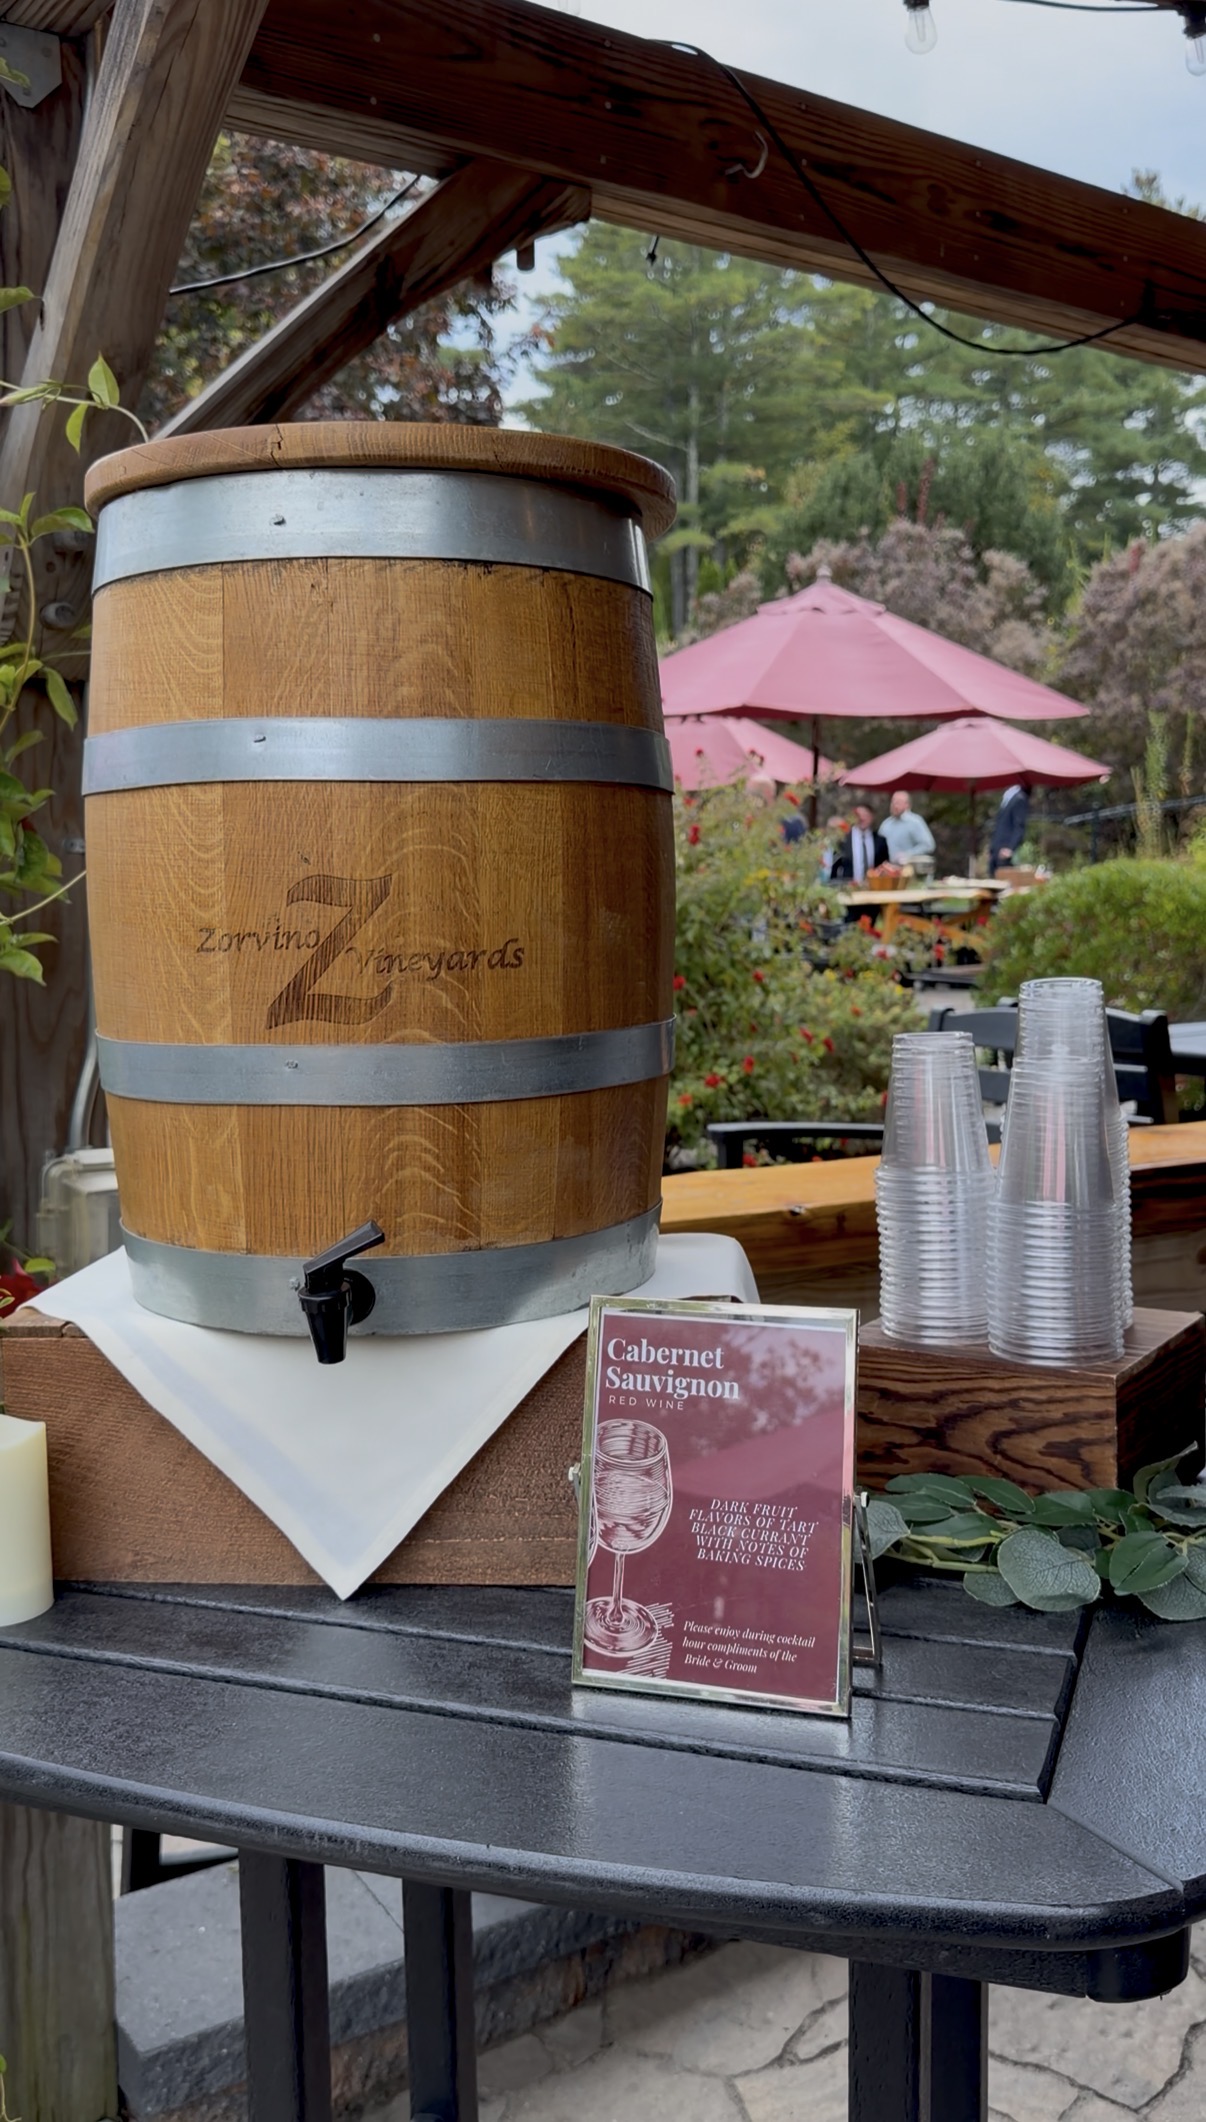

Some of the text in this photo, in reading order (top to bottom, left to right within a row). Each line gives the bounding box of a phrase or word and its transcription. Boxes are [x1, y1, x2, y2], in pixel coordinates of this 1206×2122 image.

[197, 924, 525, 980] Zorvino Vineyards
[607, 1338, 724, 1369] Cabernet
[605, 1366, 740, 1400] Sauvignon
[609, 1395, 685, 1411] RED WINE
[711, 1499, 797, 1518] DARK FRUIT
[689, 1509, 819, 1534] FLAVORS OF TART
[691, 1522, 811, 1545] BLACK CURRANT
[696, 1535, 809, 1559] WITH NOTES OF
[697, 1549, 805, 1571] BAKING SPICES
[683, 1621, 816, 1648] Please enjoy during cocktail
[682, 1637, 798, 1663] hour compliments of the
[684, 1654, 757, 1673] Bride & Groom
